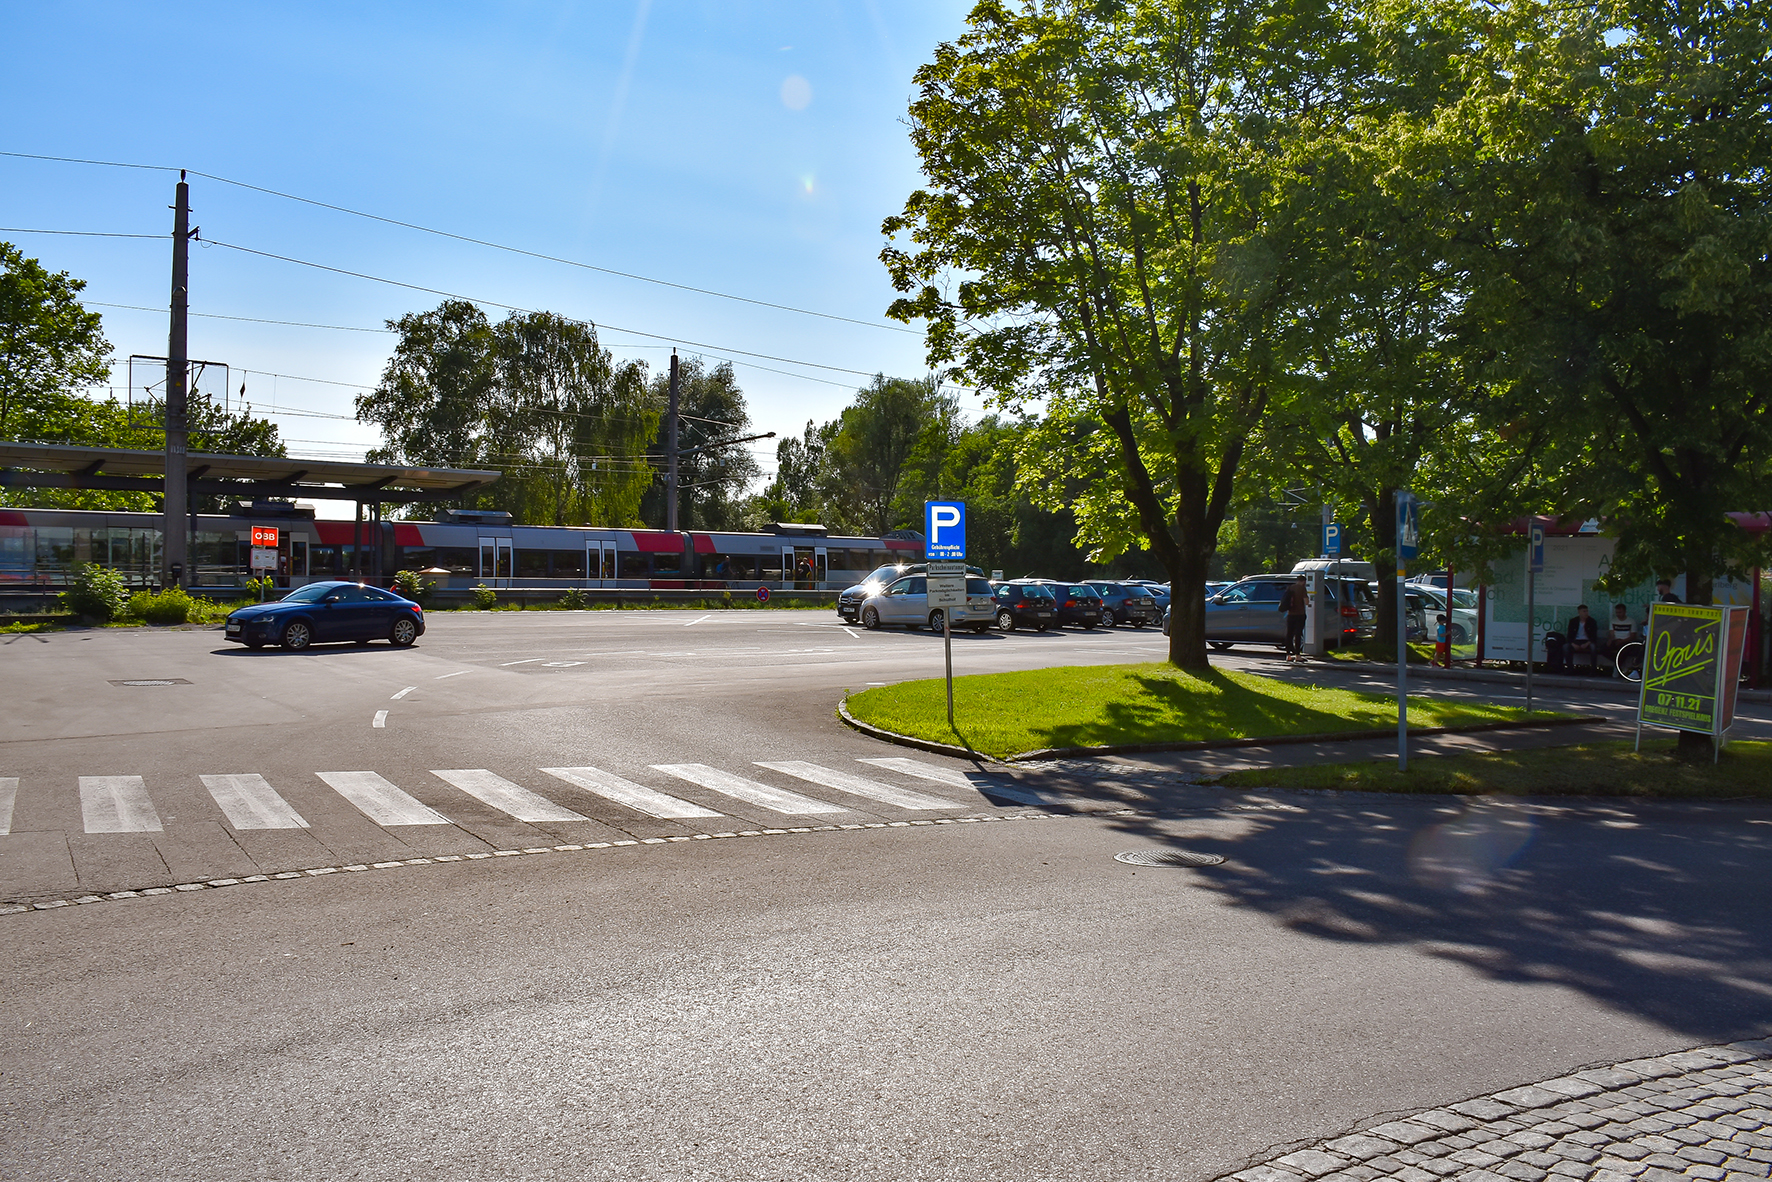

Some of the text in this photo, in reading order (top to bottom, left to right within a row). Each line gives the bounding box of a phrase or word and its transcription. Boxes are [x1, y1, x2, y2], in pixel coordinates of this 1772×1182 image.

[931, 506, 961, 544] P
[1326, 526, 1338, 545] P
[1532, 529, 1543, 560] P
[1653, 631, 1714, 687] Opus
[1669, 708, 1712, 723] FESTSPIELHAUS
